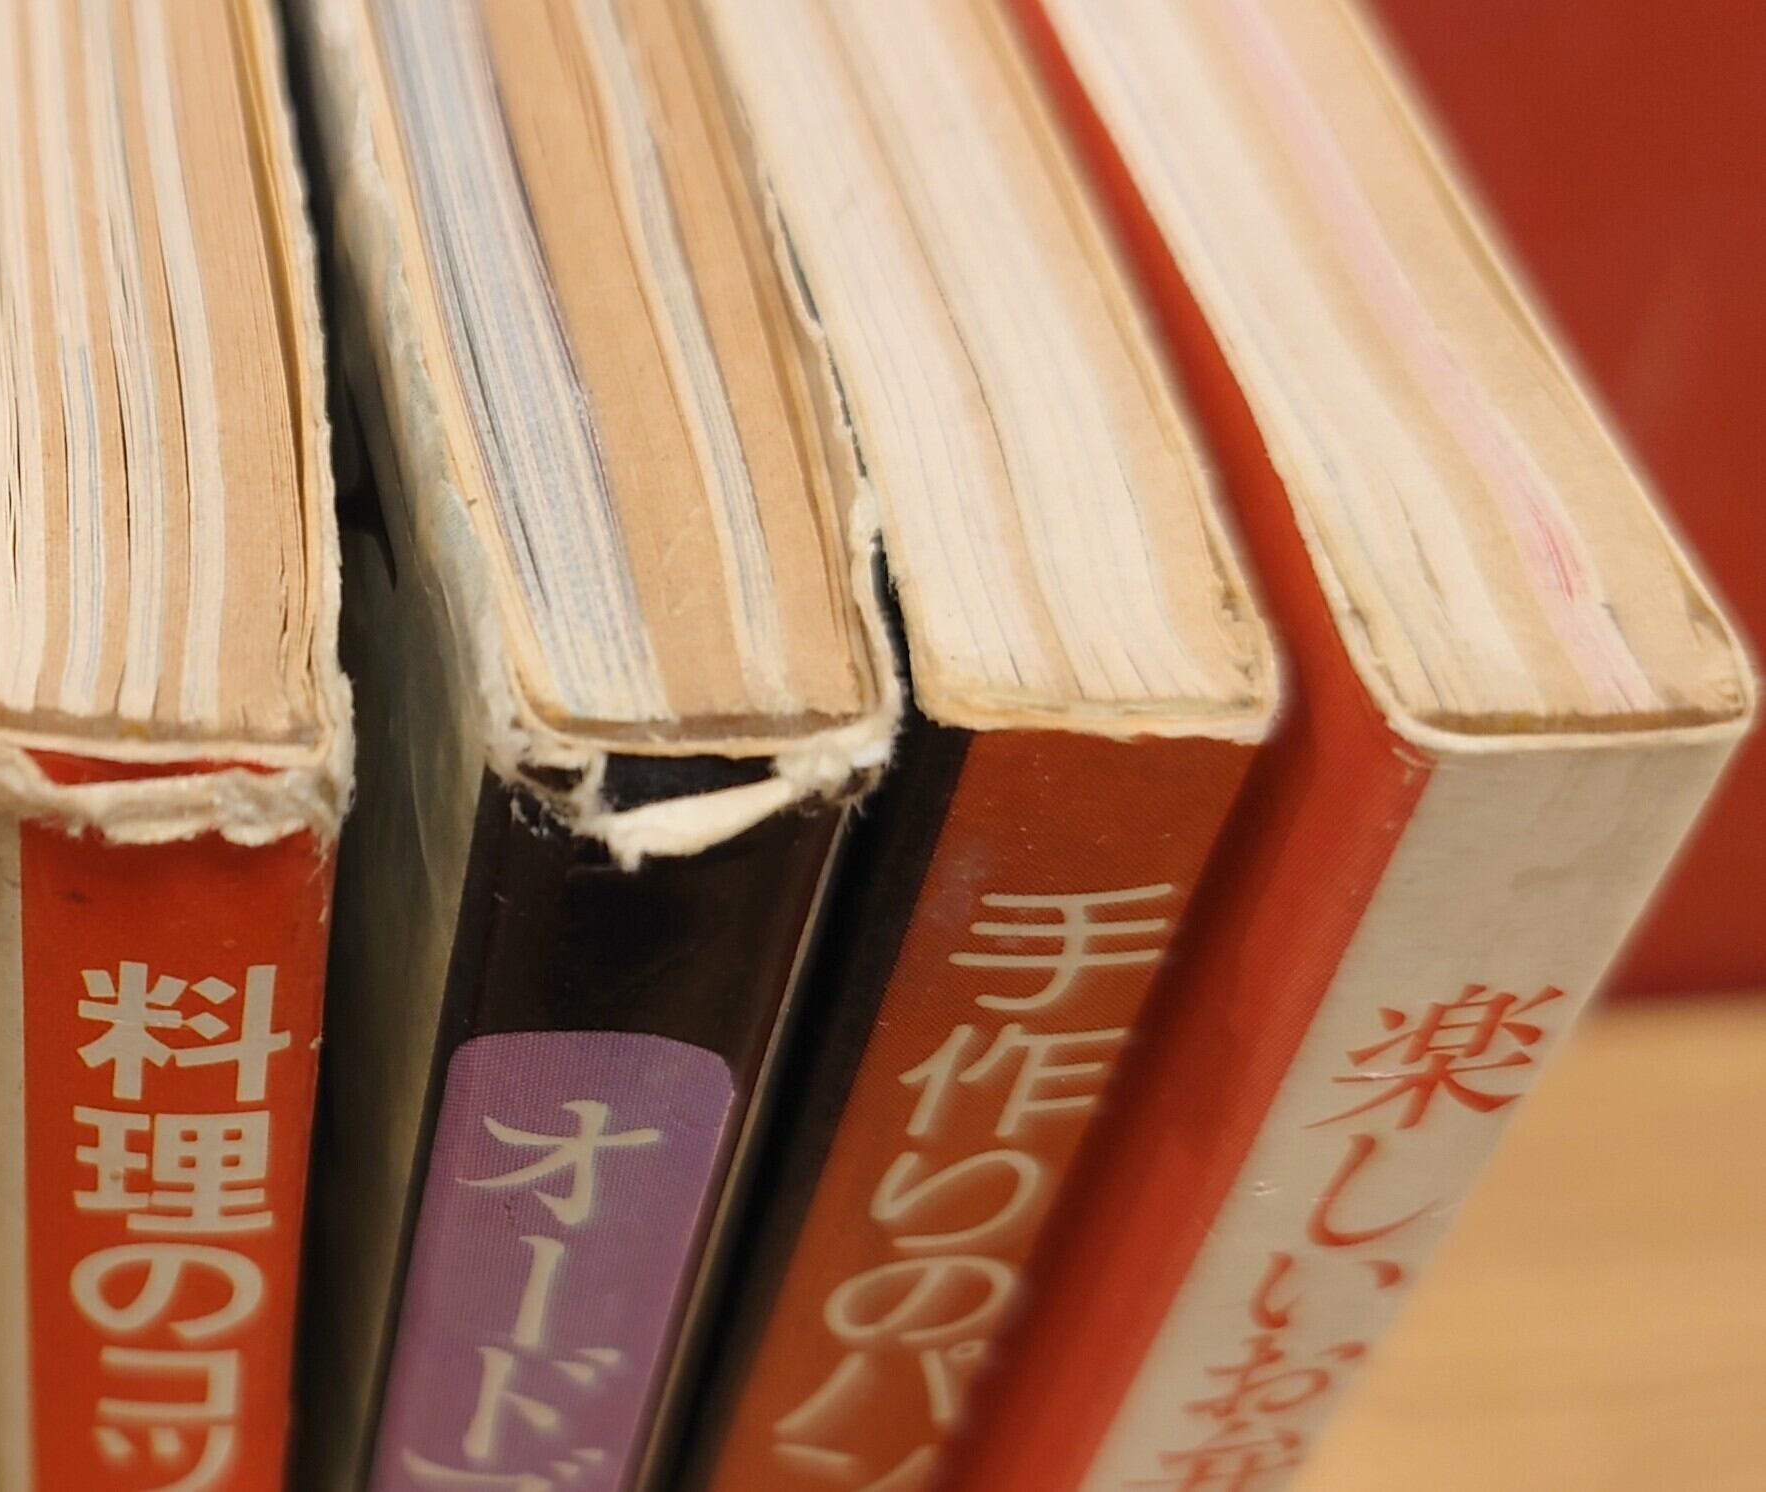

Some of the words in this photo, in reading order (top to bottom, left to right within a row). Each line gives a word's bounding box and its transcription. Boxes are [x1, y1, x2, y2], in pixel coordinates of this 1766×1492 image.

[70, 960, 291, 1492] 料理のコツ
